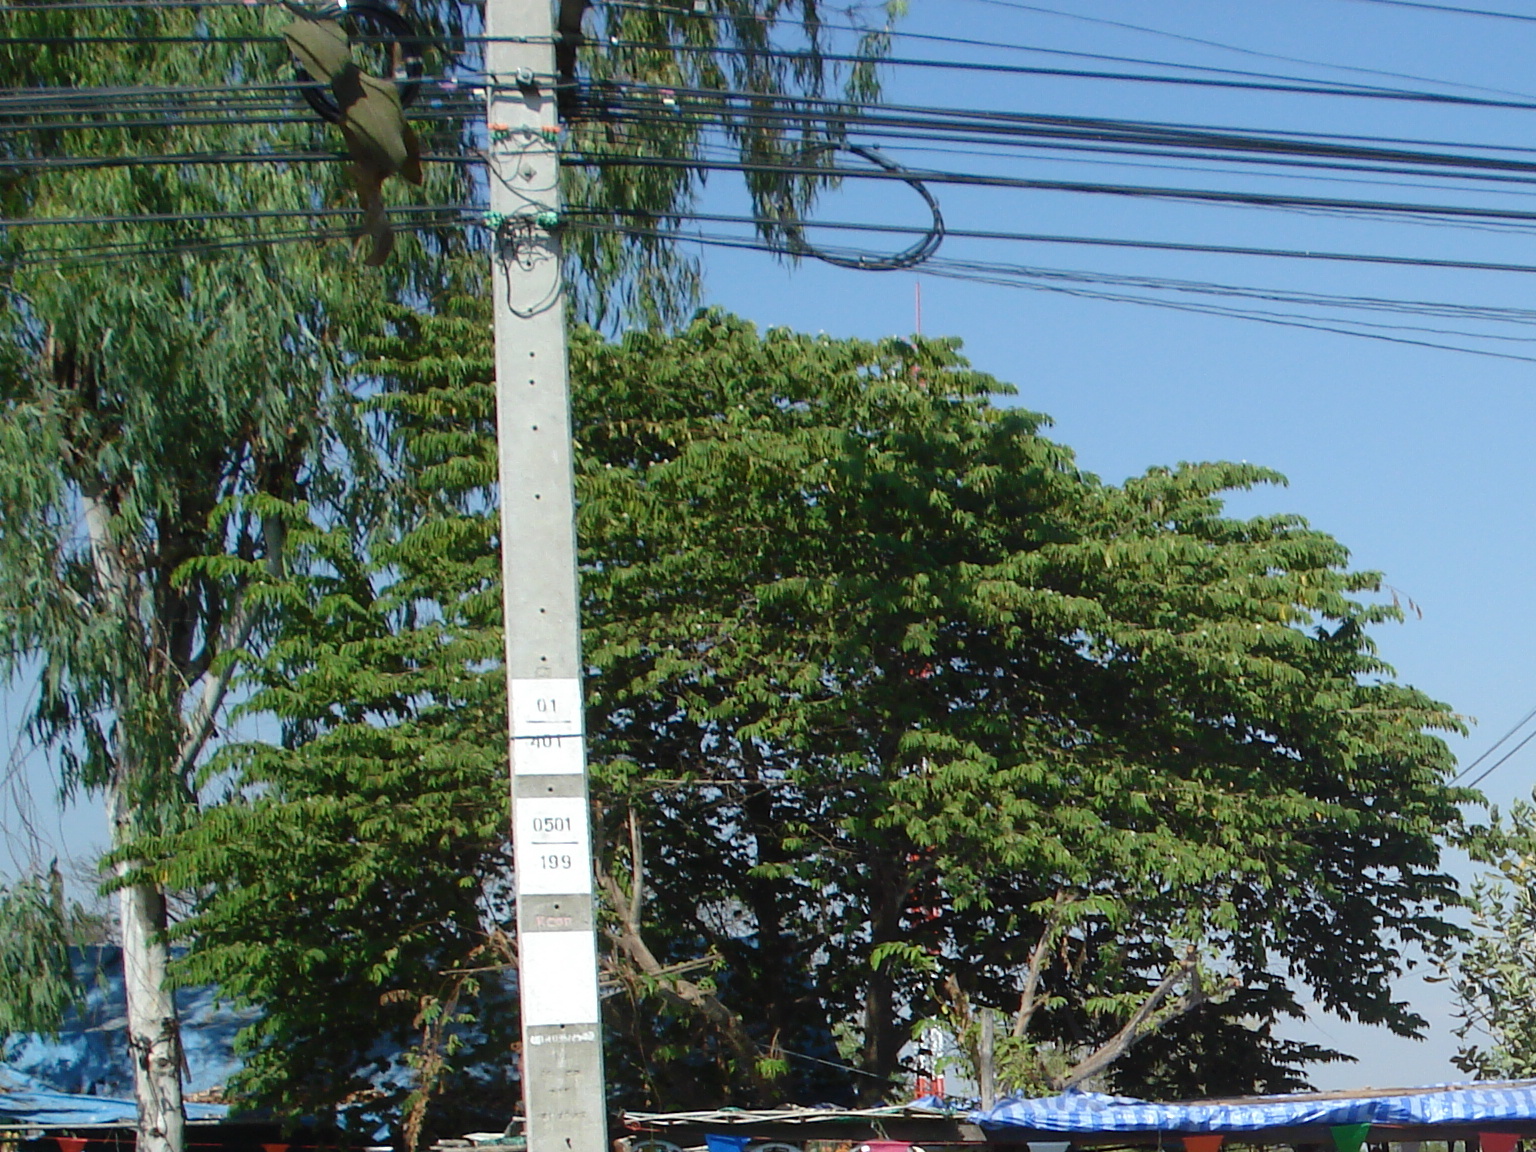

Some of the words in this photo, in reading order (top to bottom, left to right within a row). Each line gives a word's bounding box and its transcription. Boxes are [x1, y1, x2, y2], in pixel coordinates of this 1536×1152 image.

[537, 698, 556, 712] 01
[533, 817, 571, 832] 0501
[541, 854, 571, 869] 199
